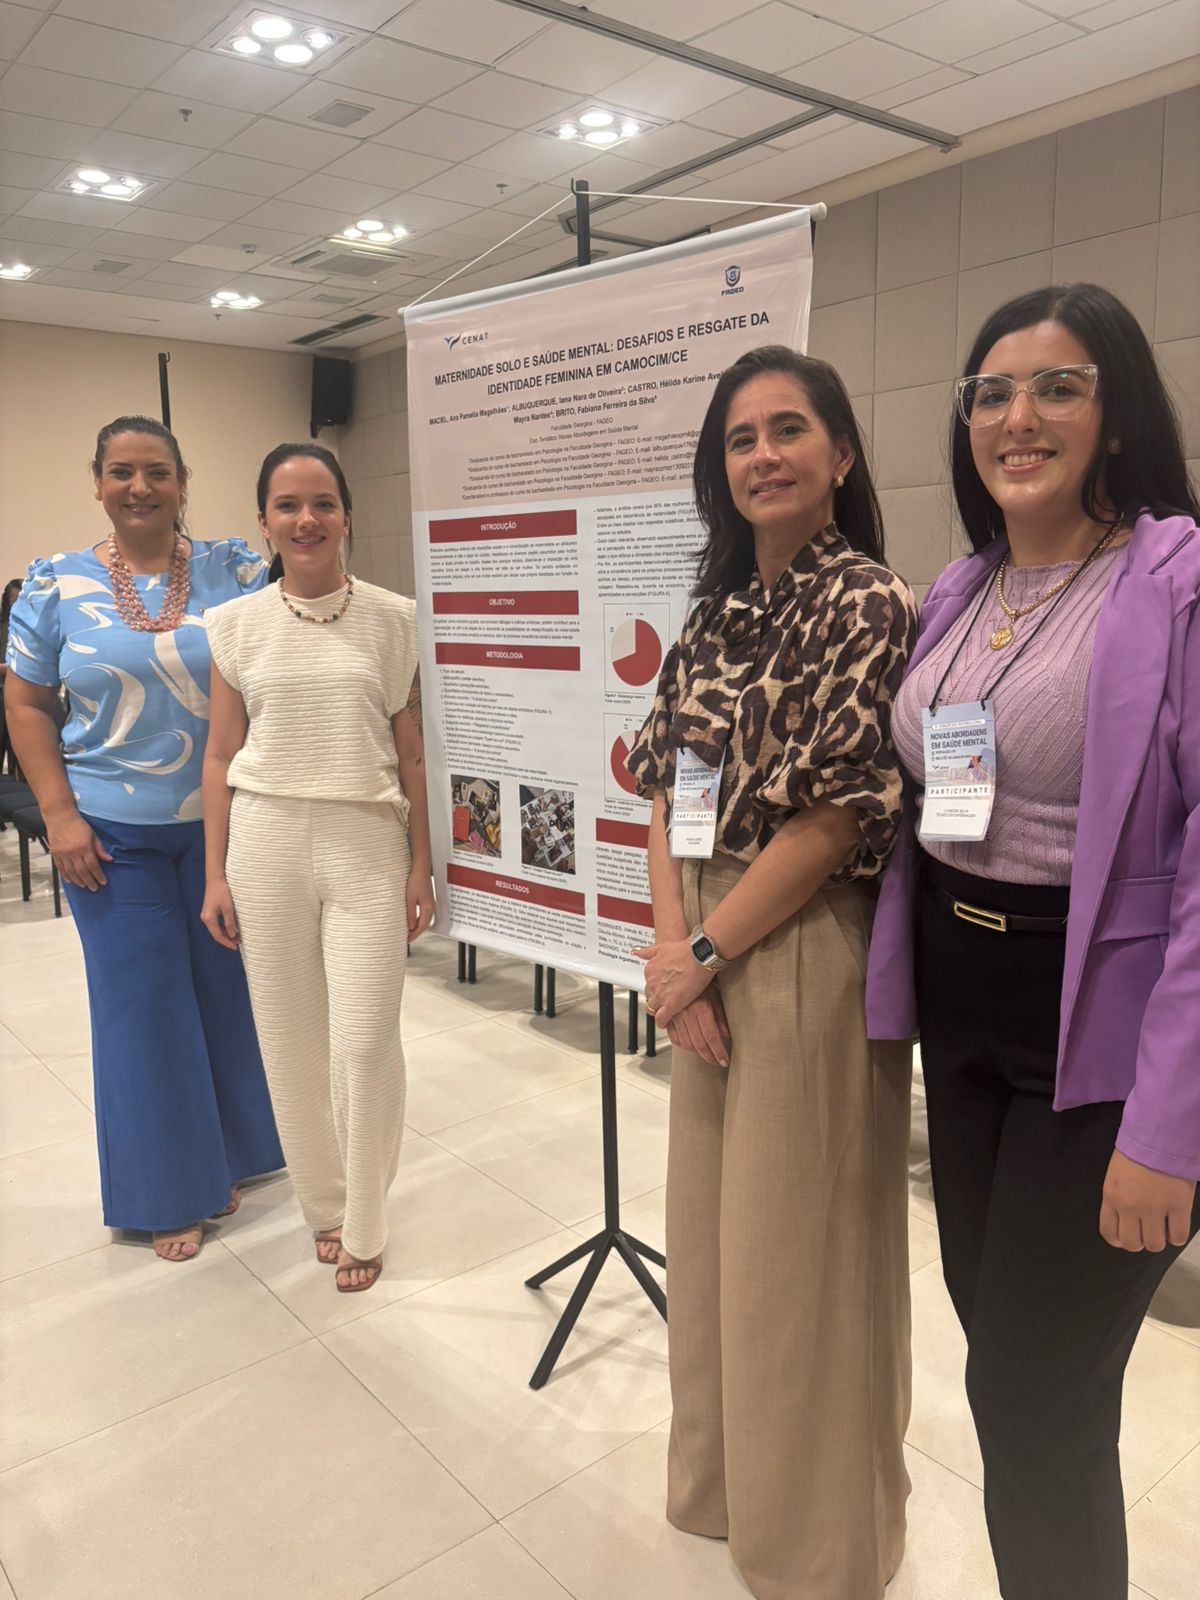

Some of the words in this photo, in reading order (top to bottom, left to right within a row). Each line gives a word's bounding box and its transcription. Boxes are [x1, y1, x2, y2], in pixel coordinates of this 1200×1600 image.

[462, 332, 488, 345] CENAT
[434, 364, 494, 386] MATERNIDADE
[496, 358, 522, 374] SOLO
[524, 356, 530, 368] E
[532, 350, 566, 367] SAÚDE
[568, 342, 614, 360] MENTAL:
[616, 328, 674, 350] DESAFIOS
[677, 326, 684, 340] E
[688, 314, 747, 338] RESGATE
[750, 311, 770, 326] DA
[488, 379, 542, 396] IDENTIDADE
[544, 366, 594, 386] FEMININA
[596, 364, 612, 376] EM
[614, 349, 688, 373] CAMOCIM/CE
[429, 416, 448, 424] MACIEL,
[512, 398, 558, 412] ALBUQUERQUE,
[628, 382, 658, 393] CASTRO,
[682, 374, 706, 384] Karine
[514, 416, 530, 424] Mayra
[556, 408, 576, 417] BRITO,
[578, 404, 601, 414] Fabiana
[603, 401, 627, 410] Ferreira
[480, 522, 516, 531] INTRODUÇÃO
[486, 651, 524, 660] METODOLOGIA
[931, 732, 950, 740] NOVAS
[952, 728, 988, 738] ABORDAGENS
[963, 738, 987, 746] MENTAL
[496, 880, 530, 894] RESULTADOS
